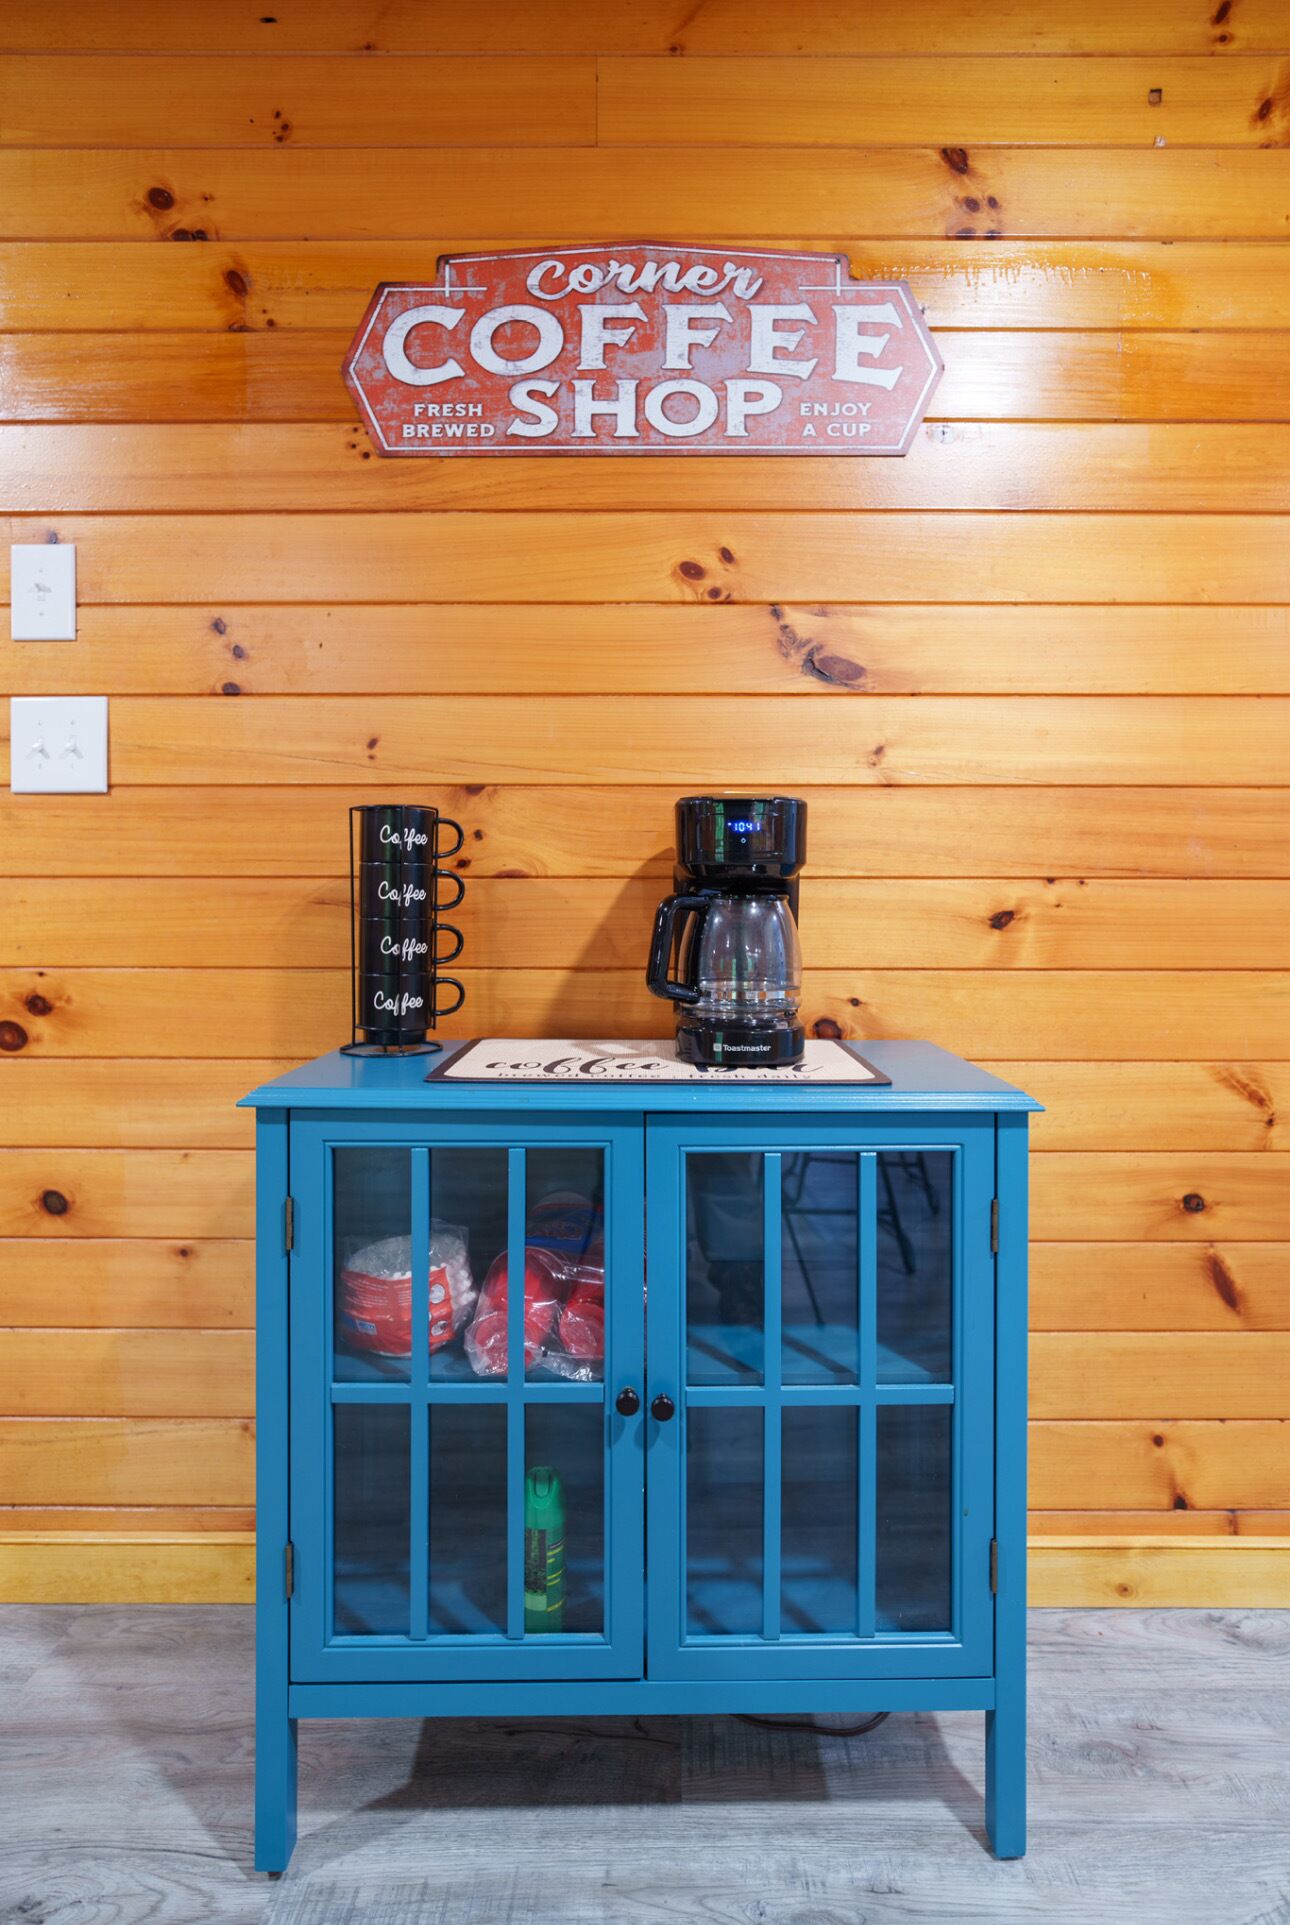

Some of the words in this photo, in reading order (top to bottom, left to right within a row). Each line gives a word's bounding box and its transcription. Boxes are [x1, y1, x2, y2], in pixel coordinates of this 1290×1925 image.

[382, 301, 904, 391] COFFEE
[414, 403, 483, 417] FRESH
[506, 379, 783, 438] SHOP
[800, 402, 872, 416] ENJOY
[402, 423, 495, 438] BREWED
[802, 423, 816, 437] A
[826, 423, 871, 437] CUP
[380, 935, 428, 962] Coffee
[373, 990, 424, 1017] Coffee
[723, 1044, 771, 1052] Toastmaster
